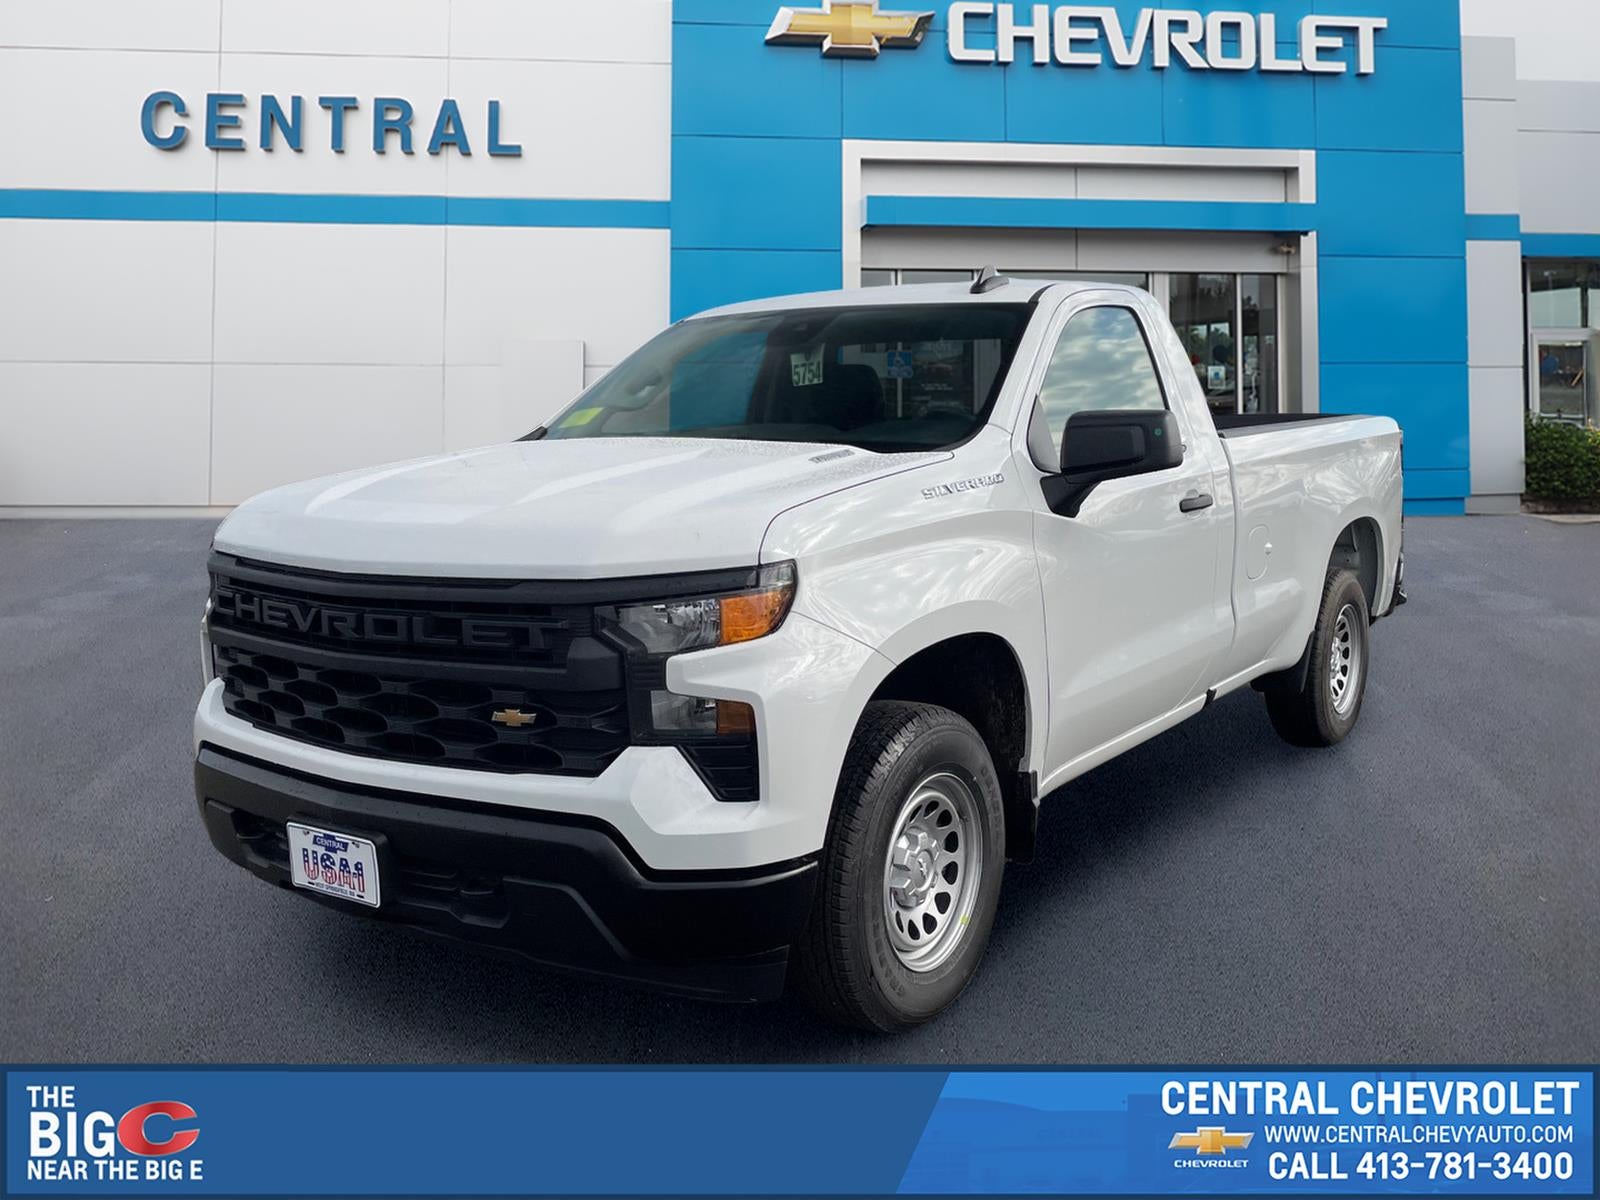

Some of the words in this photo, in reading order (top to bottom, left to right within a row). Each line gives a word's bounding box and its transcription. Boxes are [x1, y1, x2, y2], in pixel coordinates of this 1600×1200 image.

[947, 1, 1388, 75] CHEVROLET
[141, 90, 523, 158] CENTRAL
[792, 361, 822, 386] 5754
[921, 472, 1005, 500] SILVERADO
[214, 590, 568, 650] CHEVROLET
[315, 837, 345, 851] CENTRAL
